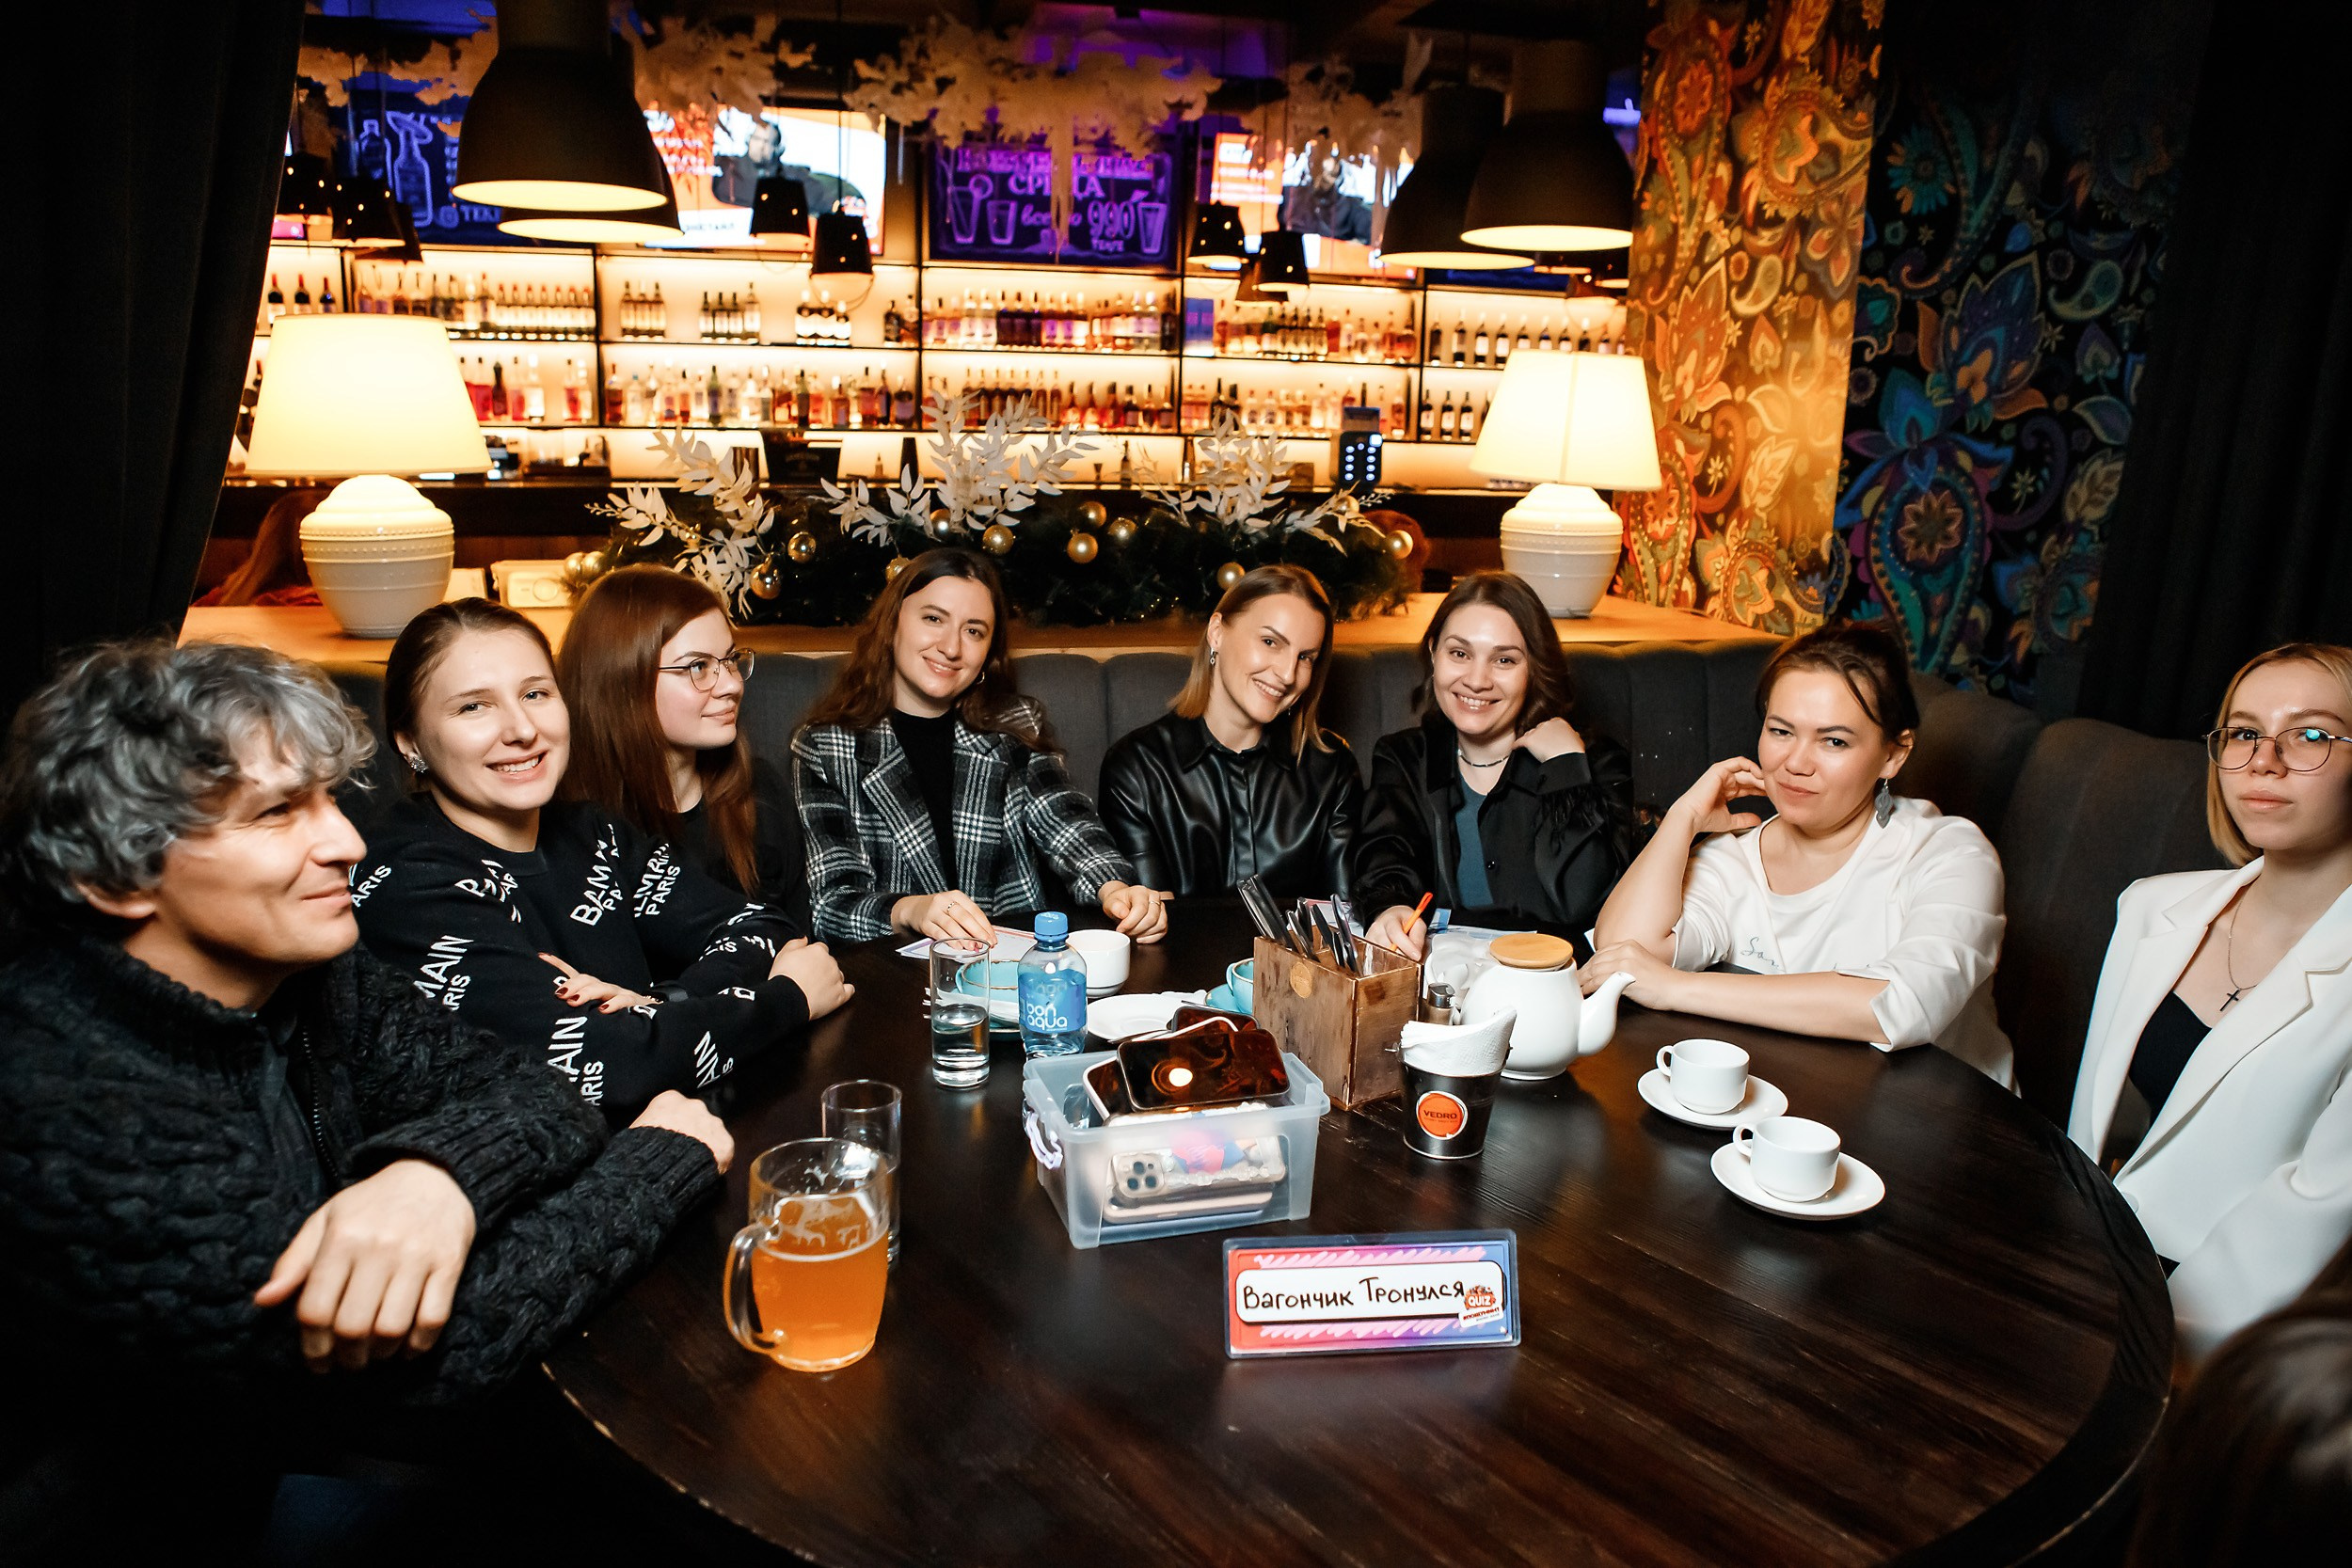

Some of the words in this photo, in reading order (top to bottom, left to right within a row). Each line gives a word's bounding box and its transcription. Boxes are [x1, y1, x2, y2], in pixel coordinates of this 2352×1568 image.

[351, 864, 392, 908] ARIS
[645, 865, 681, 916] PARIS
[413, 935, 474, 999] MAIN
[442, 974, 471, 1011] RIS
[1026, 1014, 1068, 1031] aqua
[580, 1060, 605, 1106] ARIS
[1423, 1109, 1458, 1120] VEDRO
[1243, 1285, 1355, 1309] Вагончик
[1359, 1276, 1465, 1304] Тронулся
[1467, 1294, 1492, 1307] QUIZ
